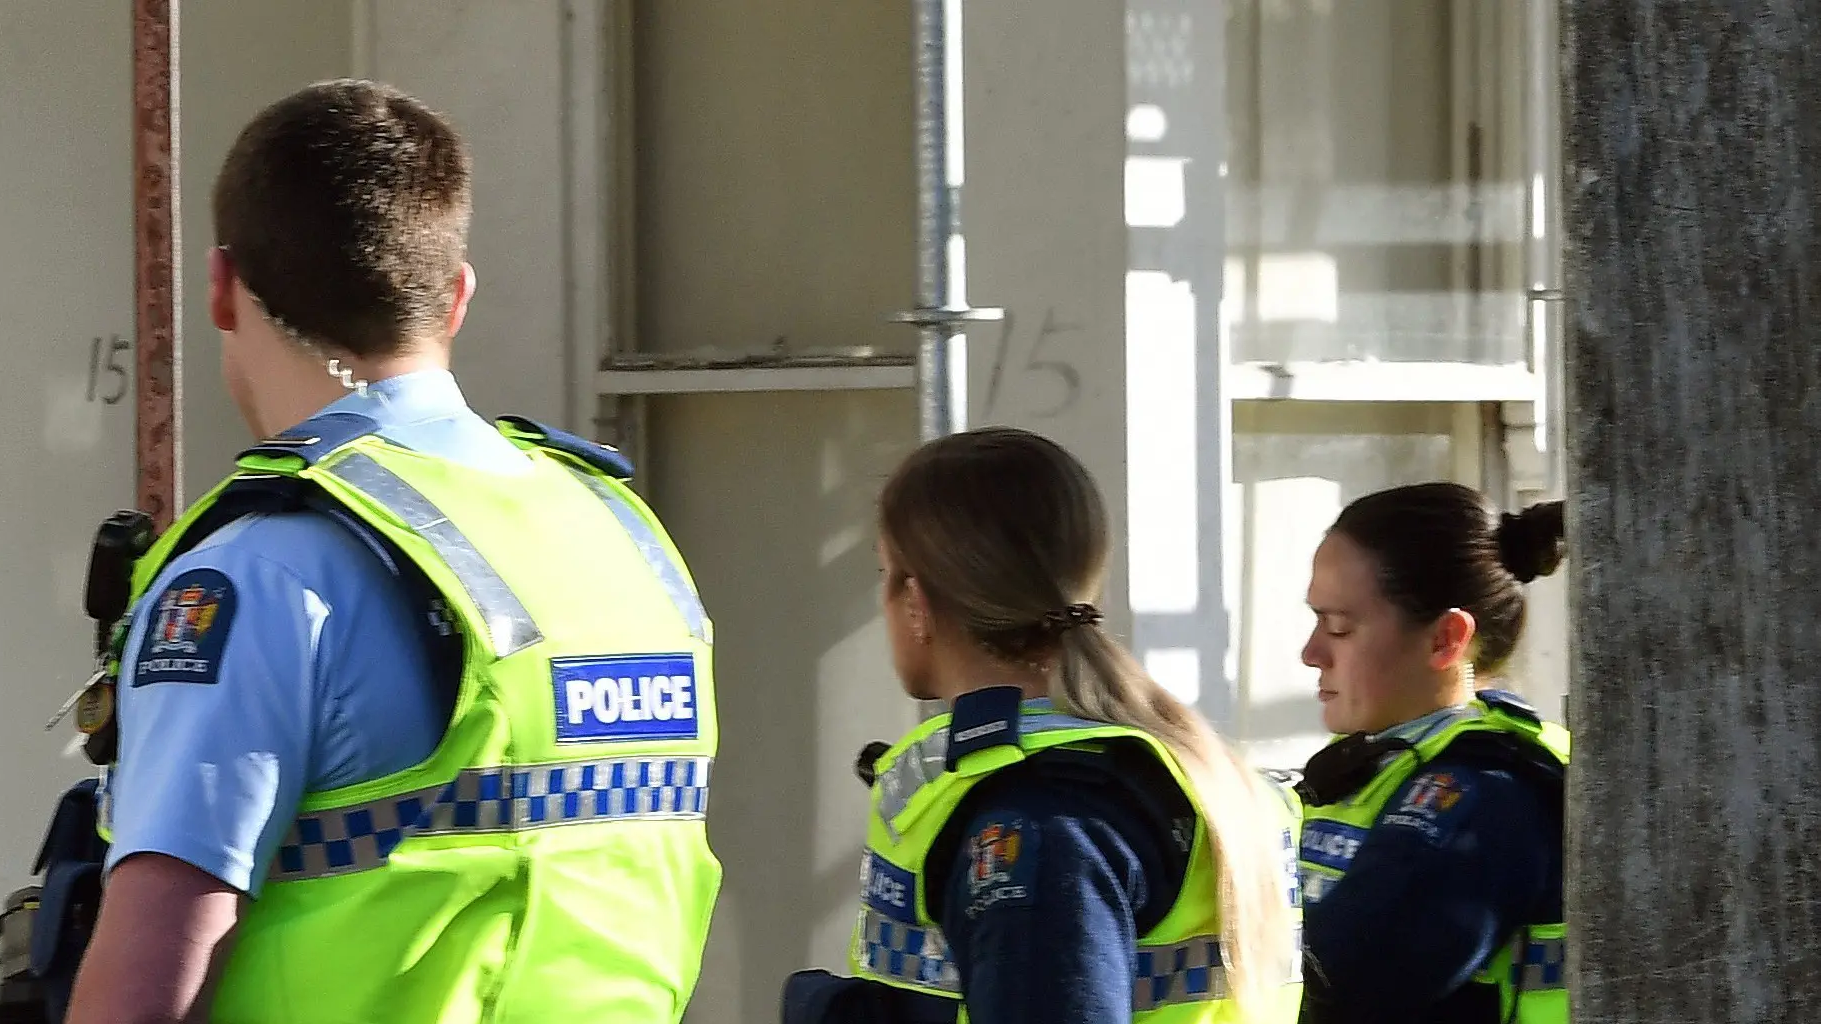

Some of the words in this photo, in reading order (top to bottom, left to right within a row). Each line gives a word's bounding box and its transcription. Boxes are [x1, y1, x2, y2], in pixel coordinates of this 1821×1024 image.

[87, 333, 133, 405] 15
[983, 307, 1085, 418] 15
[138, 658, 209, 675] POLICE
[565, 675, 694, 724] POLICE
